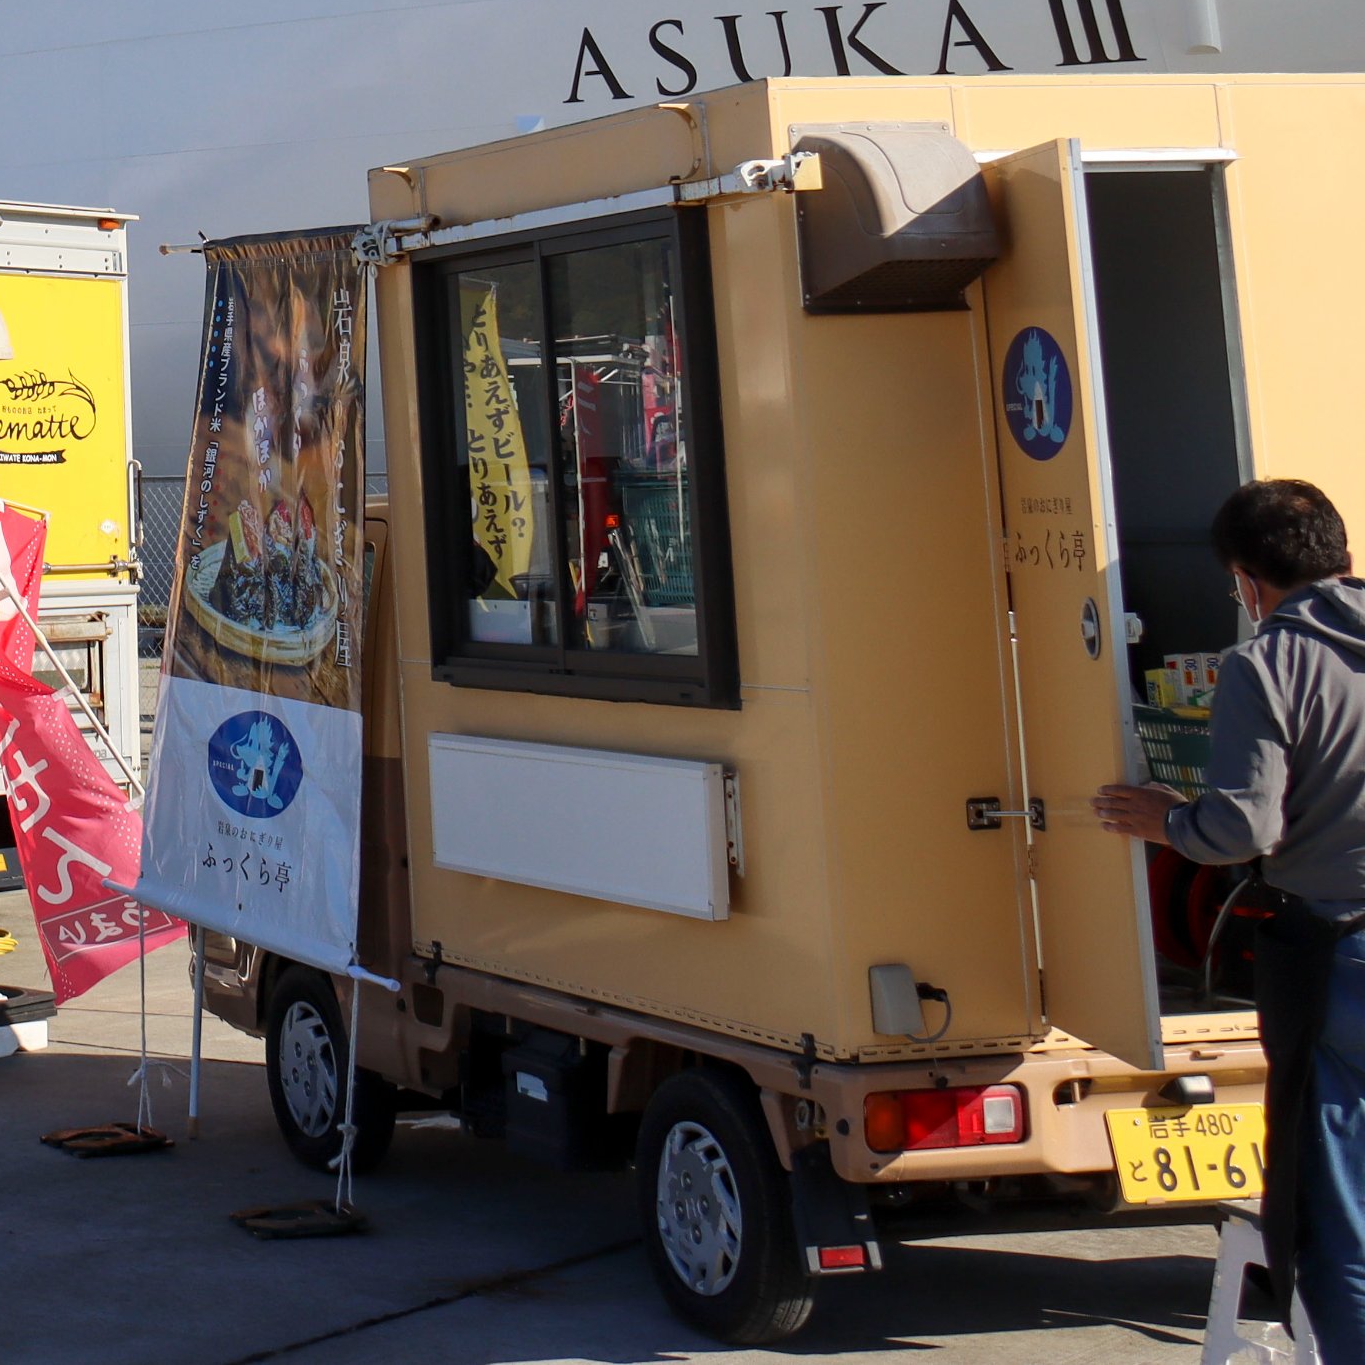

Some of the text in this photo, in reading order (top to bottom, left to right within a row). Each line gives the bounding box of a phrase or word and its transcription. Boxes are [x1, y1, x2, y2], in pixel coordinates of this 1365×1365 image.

[252, 386, 272, 493] ほかほか
[0, 453, 58, 463] IWATE KONA-MON
[1014, 529, 1086, 572] ふっくら亭
[212, 760, 235, 771] SPECIAL
[202, 842, 292, 893] ふっくら亭
[1148, 1112, 1234, 1139] 岩手 480
[1128, 1159, 1148, 1182] と
